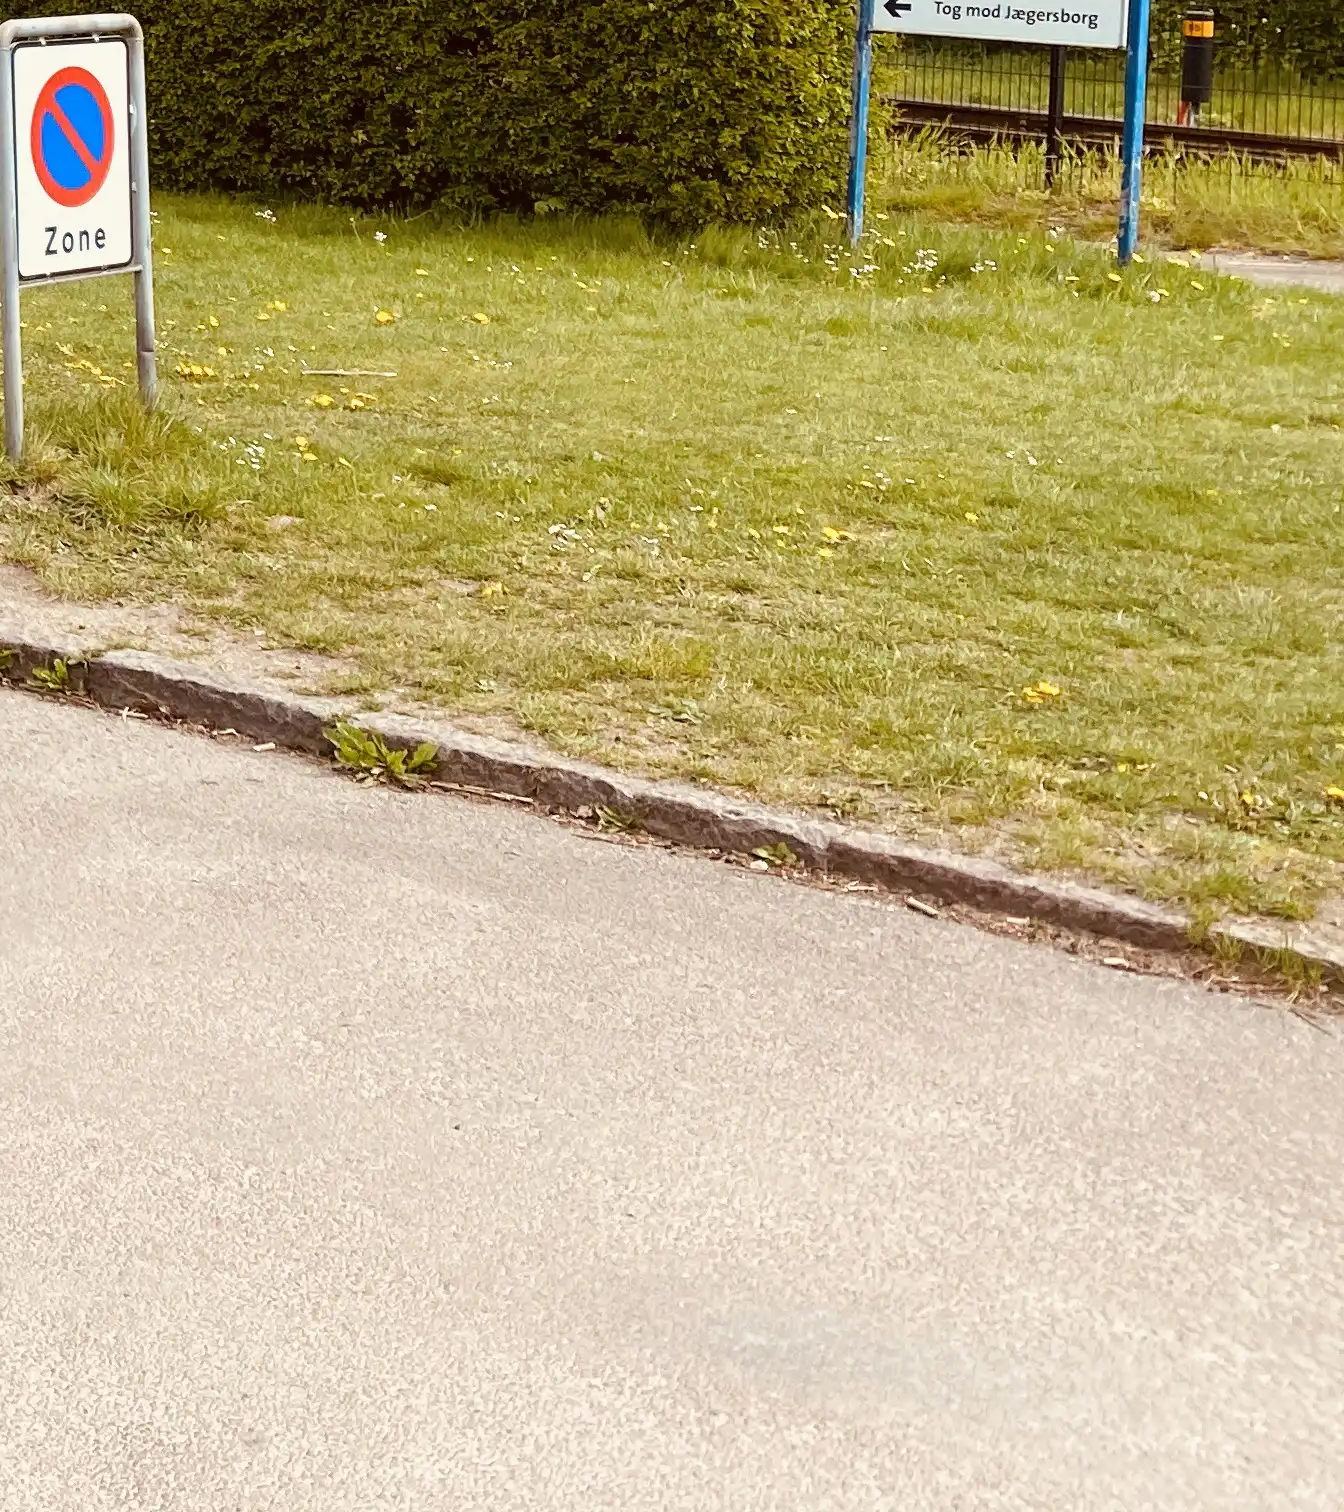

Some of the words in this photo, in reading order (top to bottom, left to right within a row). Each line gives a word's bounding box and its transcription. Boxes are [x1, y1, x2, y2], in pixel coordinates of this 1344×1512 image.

[934, 0, 962, 20] Tog
[966, 3, 1001, 19] mod
[1004, 5, 1099, 30] Jægersborg
[44, 226, 107, 256] Zone
